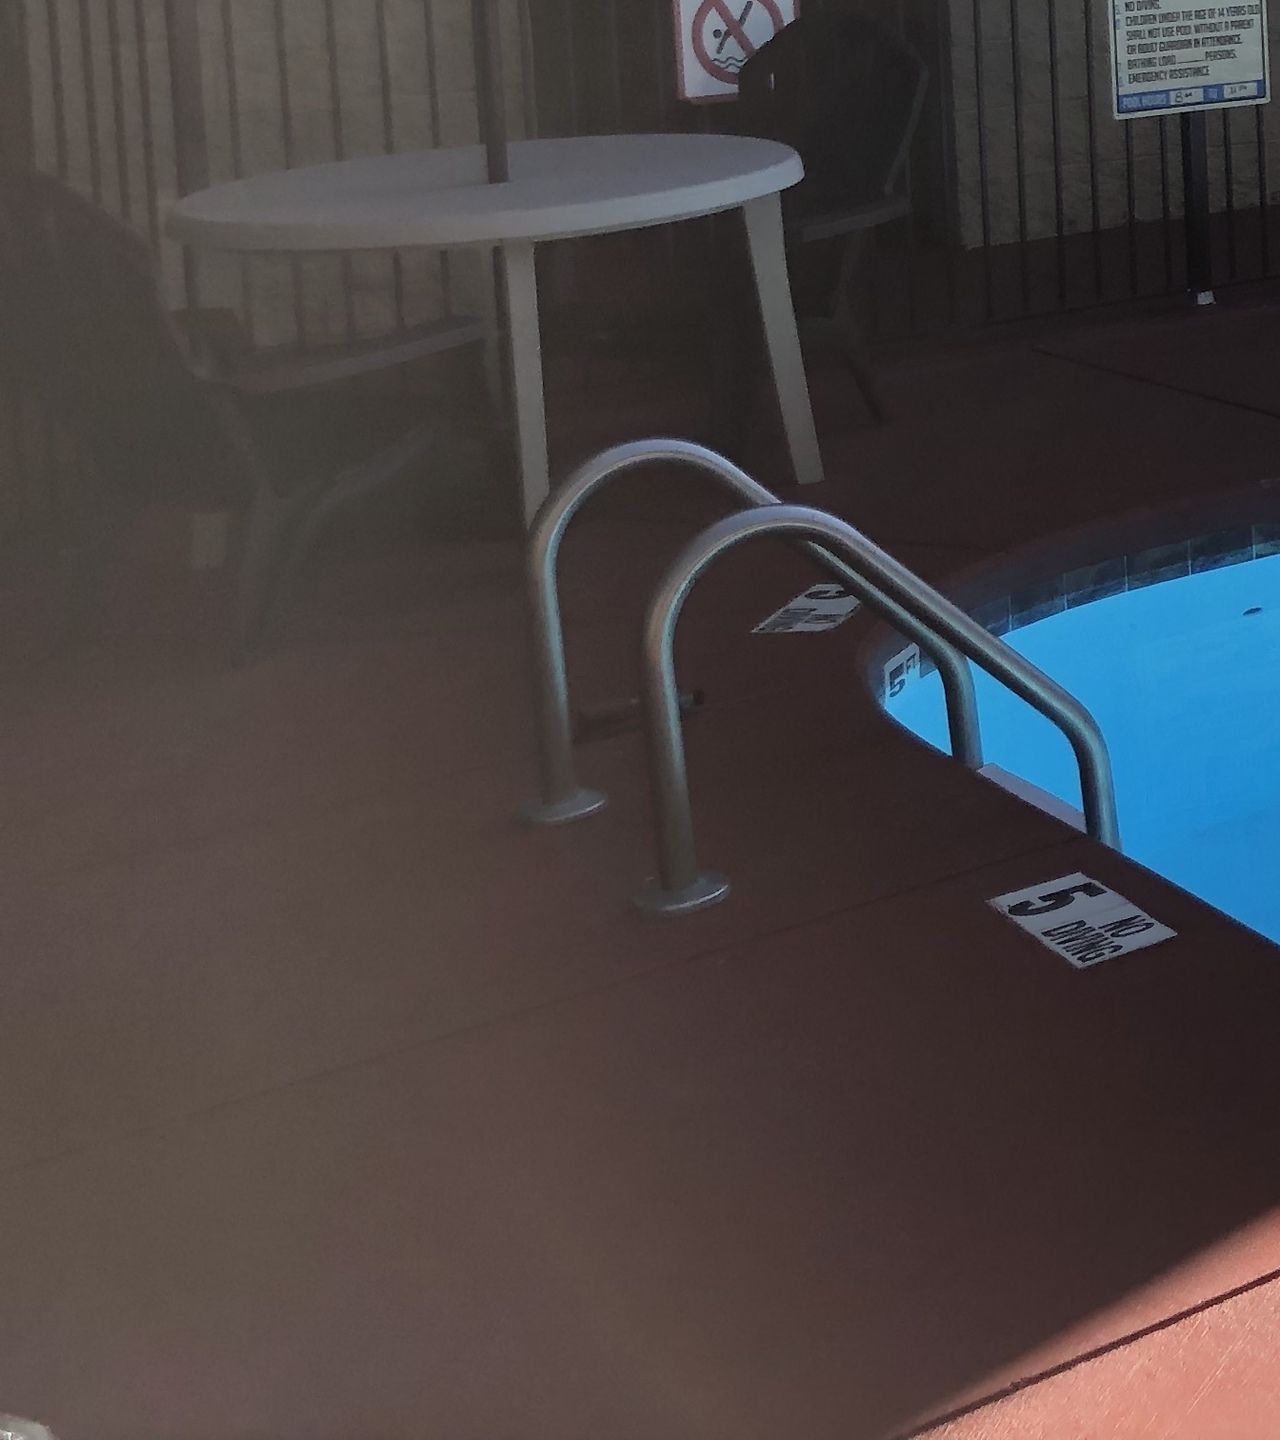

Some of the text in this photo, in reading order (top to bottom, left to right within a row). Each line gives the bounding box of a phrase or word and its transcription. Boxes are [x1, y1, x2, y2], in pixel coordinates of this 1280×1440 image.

[889, 661, 906, 697] 5
[1008, 882, 1107, 916] 5
[1041, 919, 1123, 963] DIVING
[1098, 914, 1155, 938] NO
